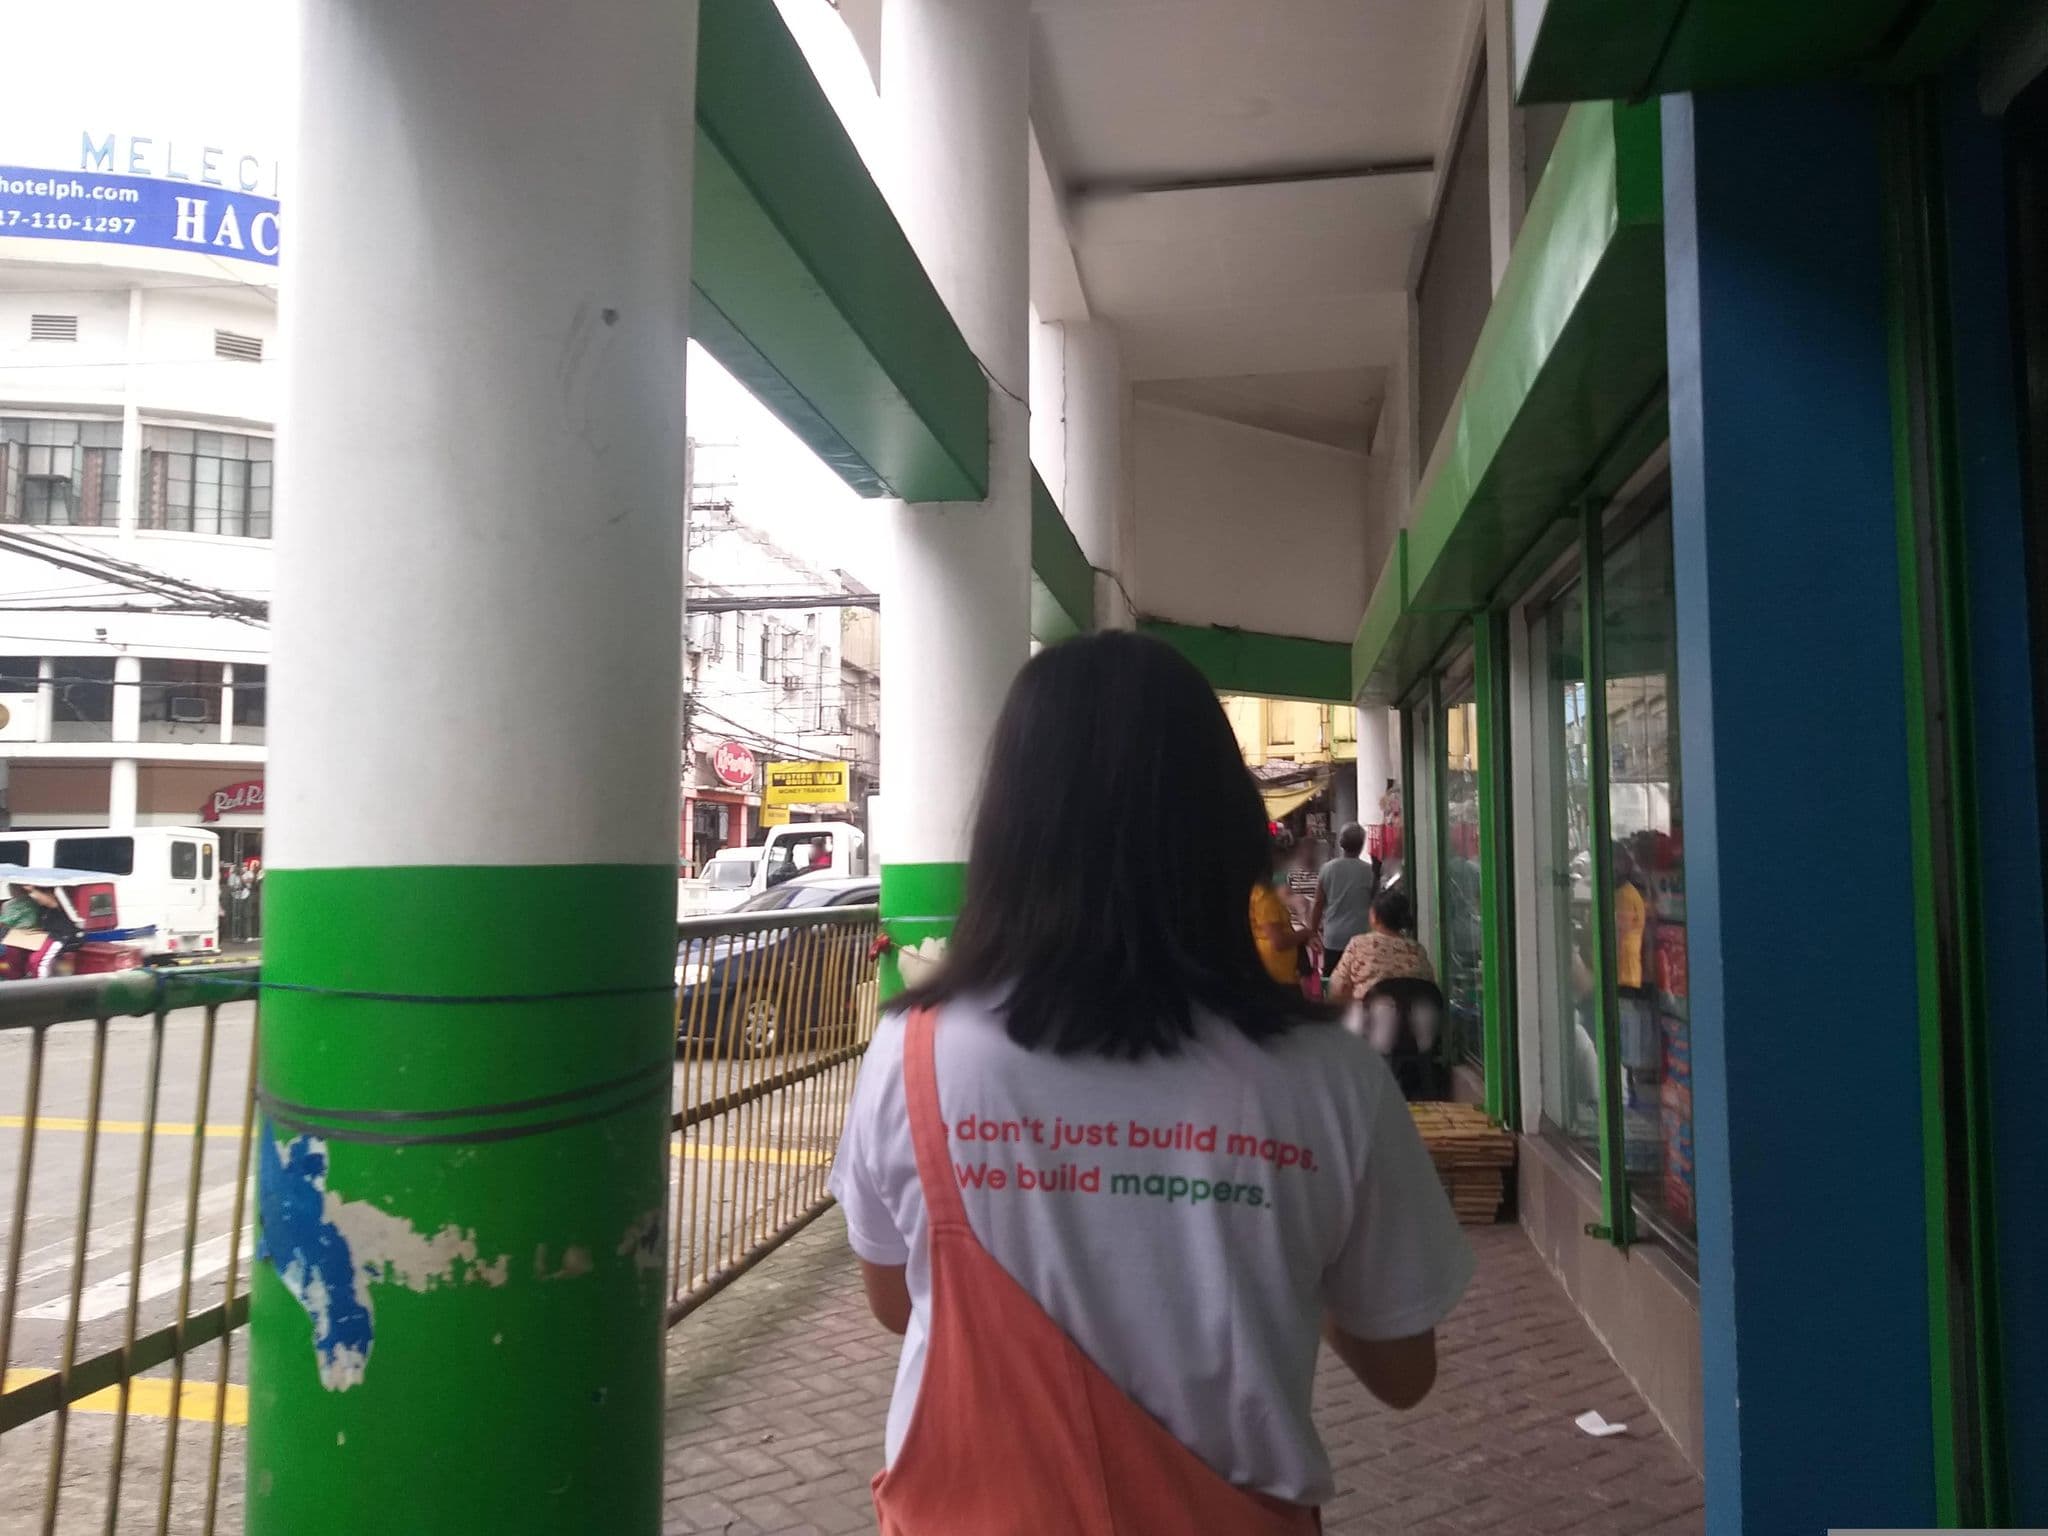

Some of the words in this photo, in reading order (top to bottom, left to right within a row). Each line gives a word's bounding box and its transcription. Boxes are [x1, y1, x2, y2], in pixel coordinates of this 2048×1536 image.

[214, 788, 245, 813] Red
[955, 1114, 1044, 1144] don't
[1050, 1117, 1118, 1151] just
[1127, 1120, 1217, 1153] build
[1226, 1130, 1319, 1173] maps.
[955, 1162, 1007, 1191] We
[1017, 1163, 1101, 1193] build
[1111, 1170, 1272, 1208] mappers.
